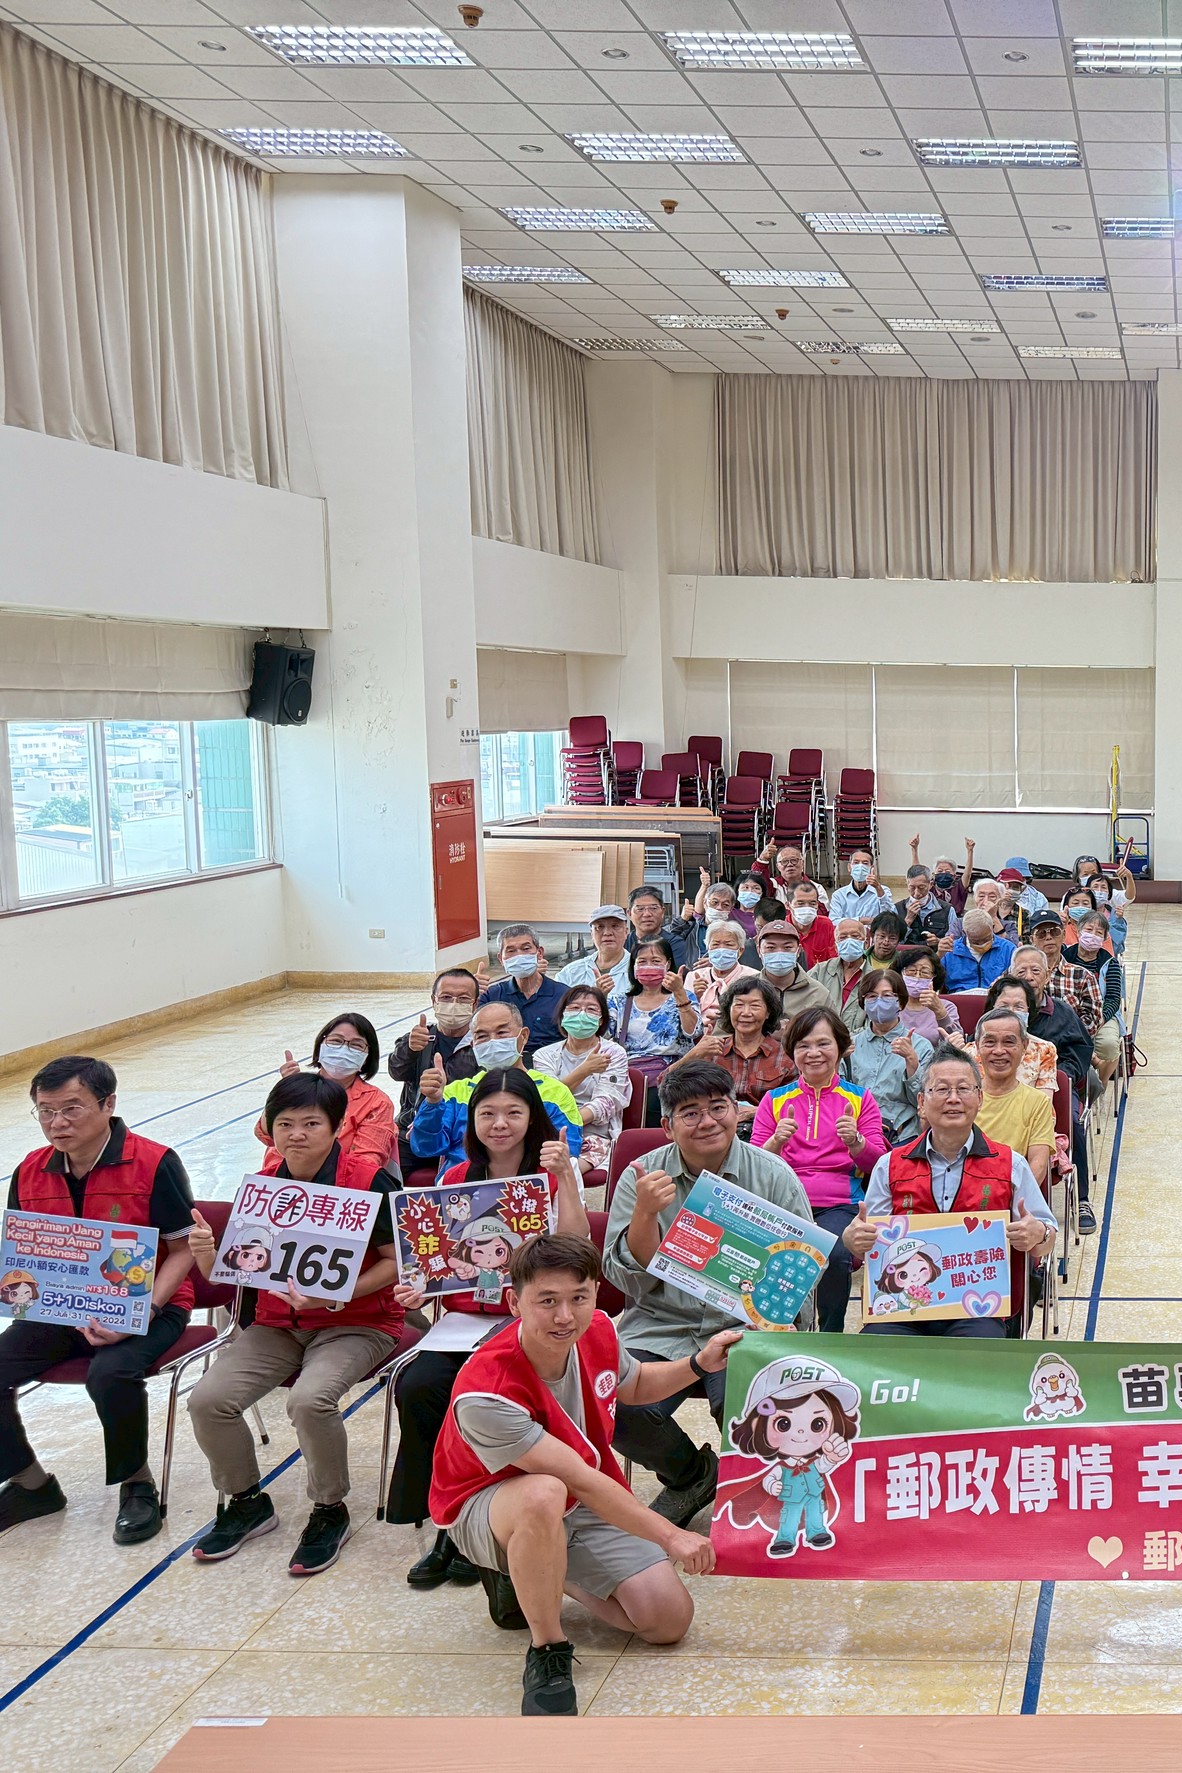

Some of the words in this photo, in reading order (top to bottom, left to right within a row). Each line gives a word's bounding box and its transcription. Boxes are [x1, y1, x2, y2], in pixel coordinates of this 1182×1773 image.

[237, 1183, 370, 1231] 防詐專線
[8, 1217, 70, 1234] Pengiriman
[73, 1225, 102, 1238] Uang
[482, 1225, 505, 1233] POST
[510, 1214, 542, 1232] 165
[7, 1229, 33, 1241] Kecil
[37, 1233, 64, 1246] yang
[67, 1238, 99, 1249] Aman
[410, 1204, 447, 1272] 小心詐騙
[17, 1244, 32, 1255] ke
[34, 1245, 87, 1261] Indonesia
[897, 1241, 916, 1255] POST
[5, 1257, 90, 1276] 印尼小額安心匯款
[270, 1241, 354, 1291] 165
[941, 1247, 1005, 1270] 郵政壽險
[951, 1266, 997, 1288] 關心您
[66, 1284, 85, 1292] admin
[40, 1308, 51, 1316] 27
[103, 1316, 125, 1325] 2024
[780, 1366, 825, 1384] POST
[871, 1379, 921, 1404] Go!
